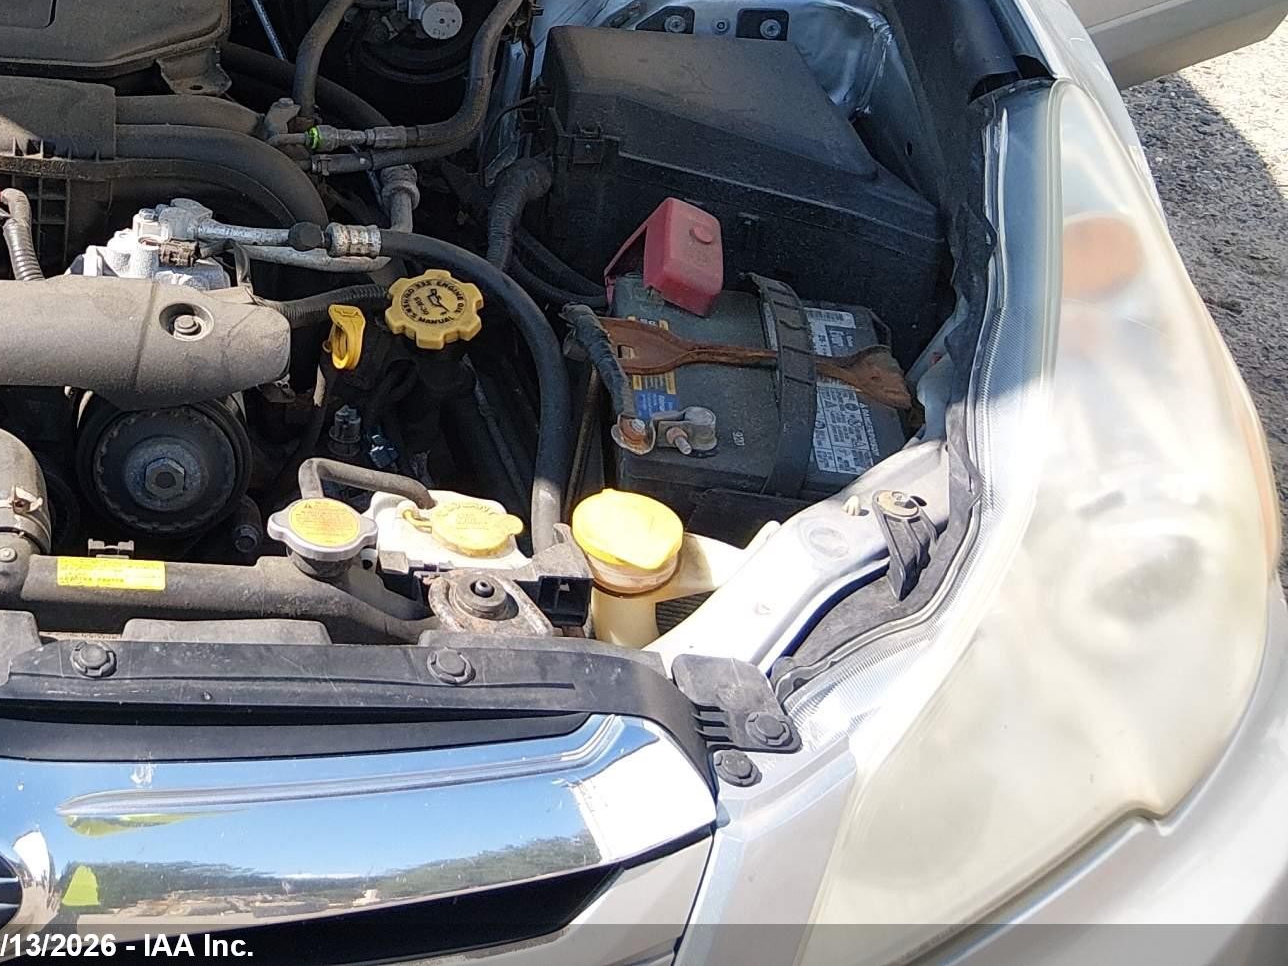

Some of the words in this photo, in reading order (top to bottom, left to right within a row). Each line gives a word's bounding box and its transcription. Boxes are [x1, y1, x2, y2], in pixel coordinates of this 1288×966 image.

[437, 281, 464, 300] ENGINE
[454, 303, 464, 313] OIL
[418, 315, 455, 324] MANUAL
